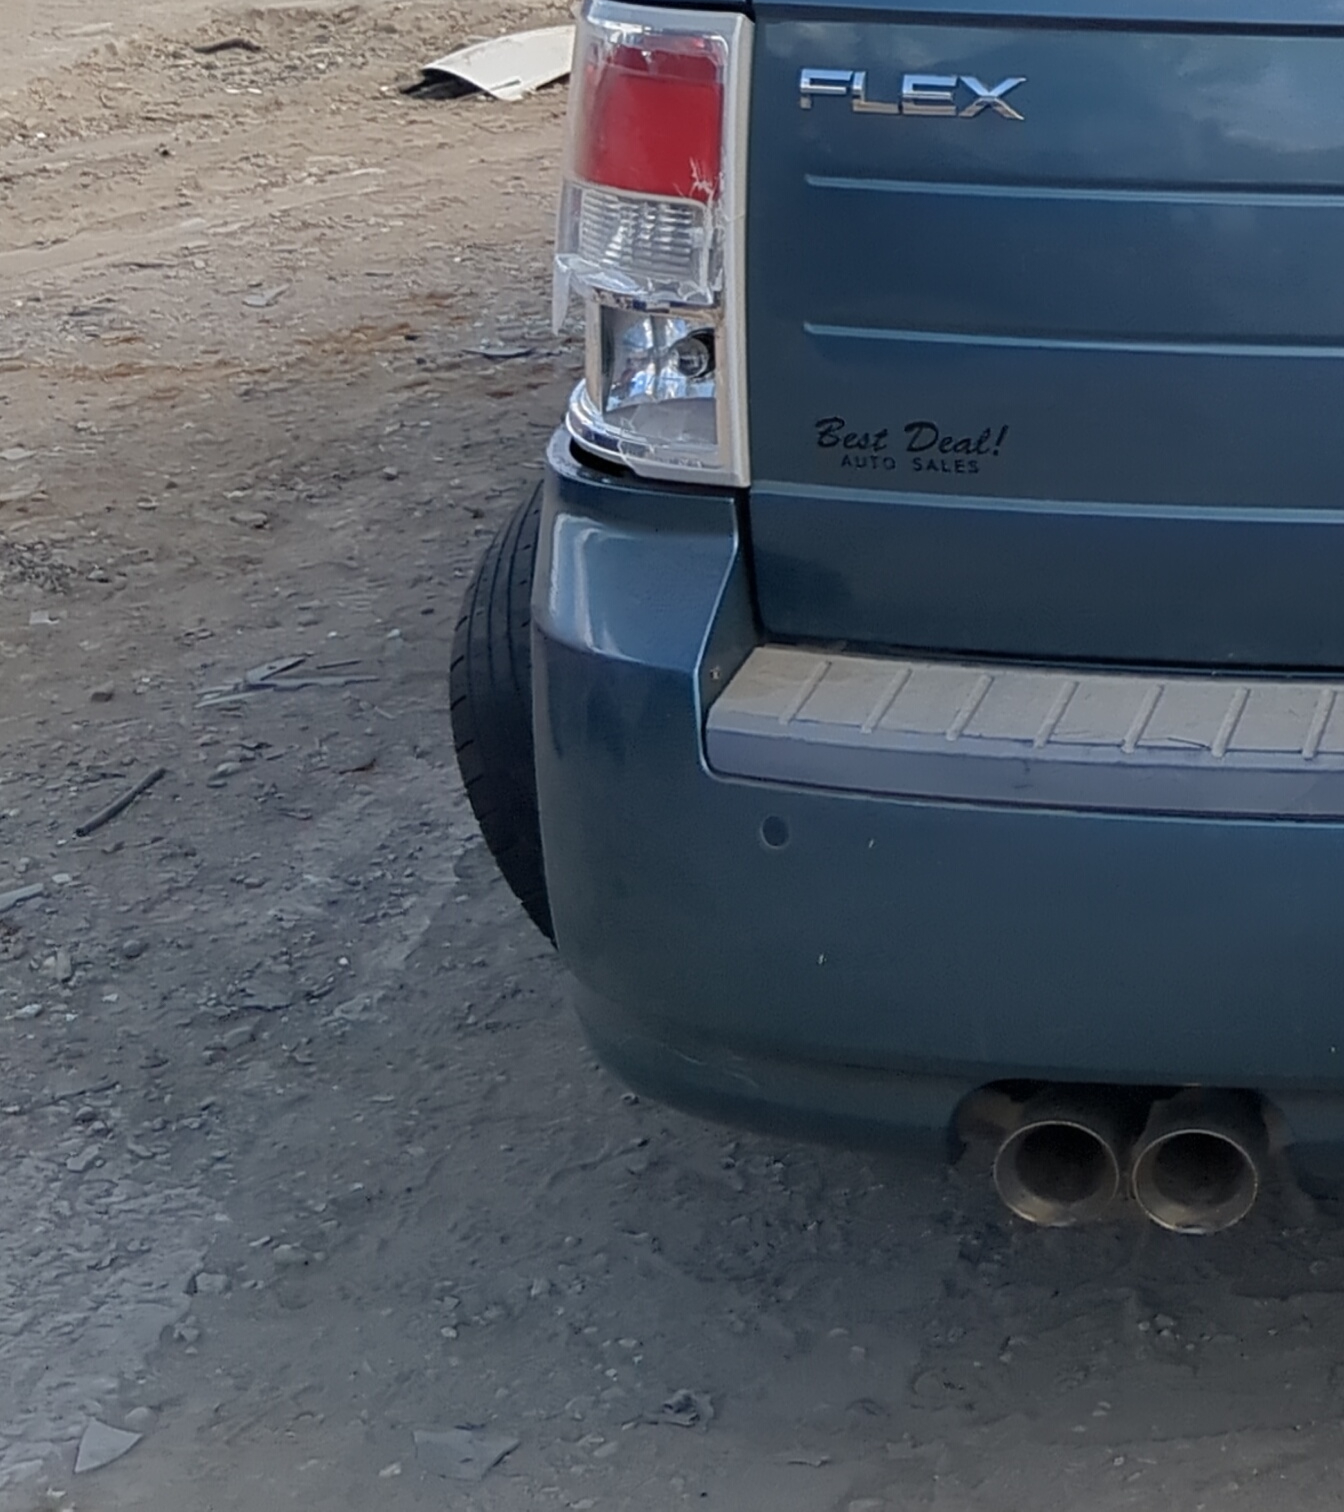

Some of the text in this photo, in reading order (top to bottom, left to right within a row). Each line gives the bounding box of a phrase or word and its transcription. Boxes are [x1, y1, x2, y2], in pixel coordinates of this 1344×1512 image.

[800, 68, 1026, 120] FLEX
[815, 416, 1009, 456] Best Deal!
[840, 453, 980, 474] AUTO SALES
